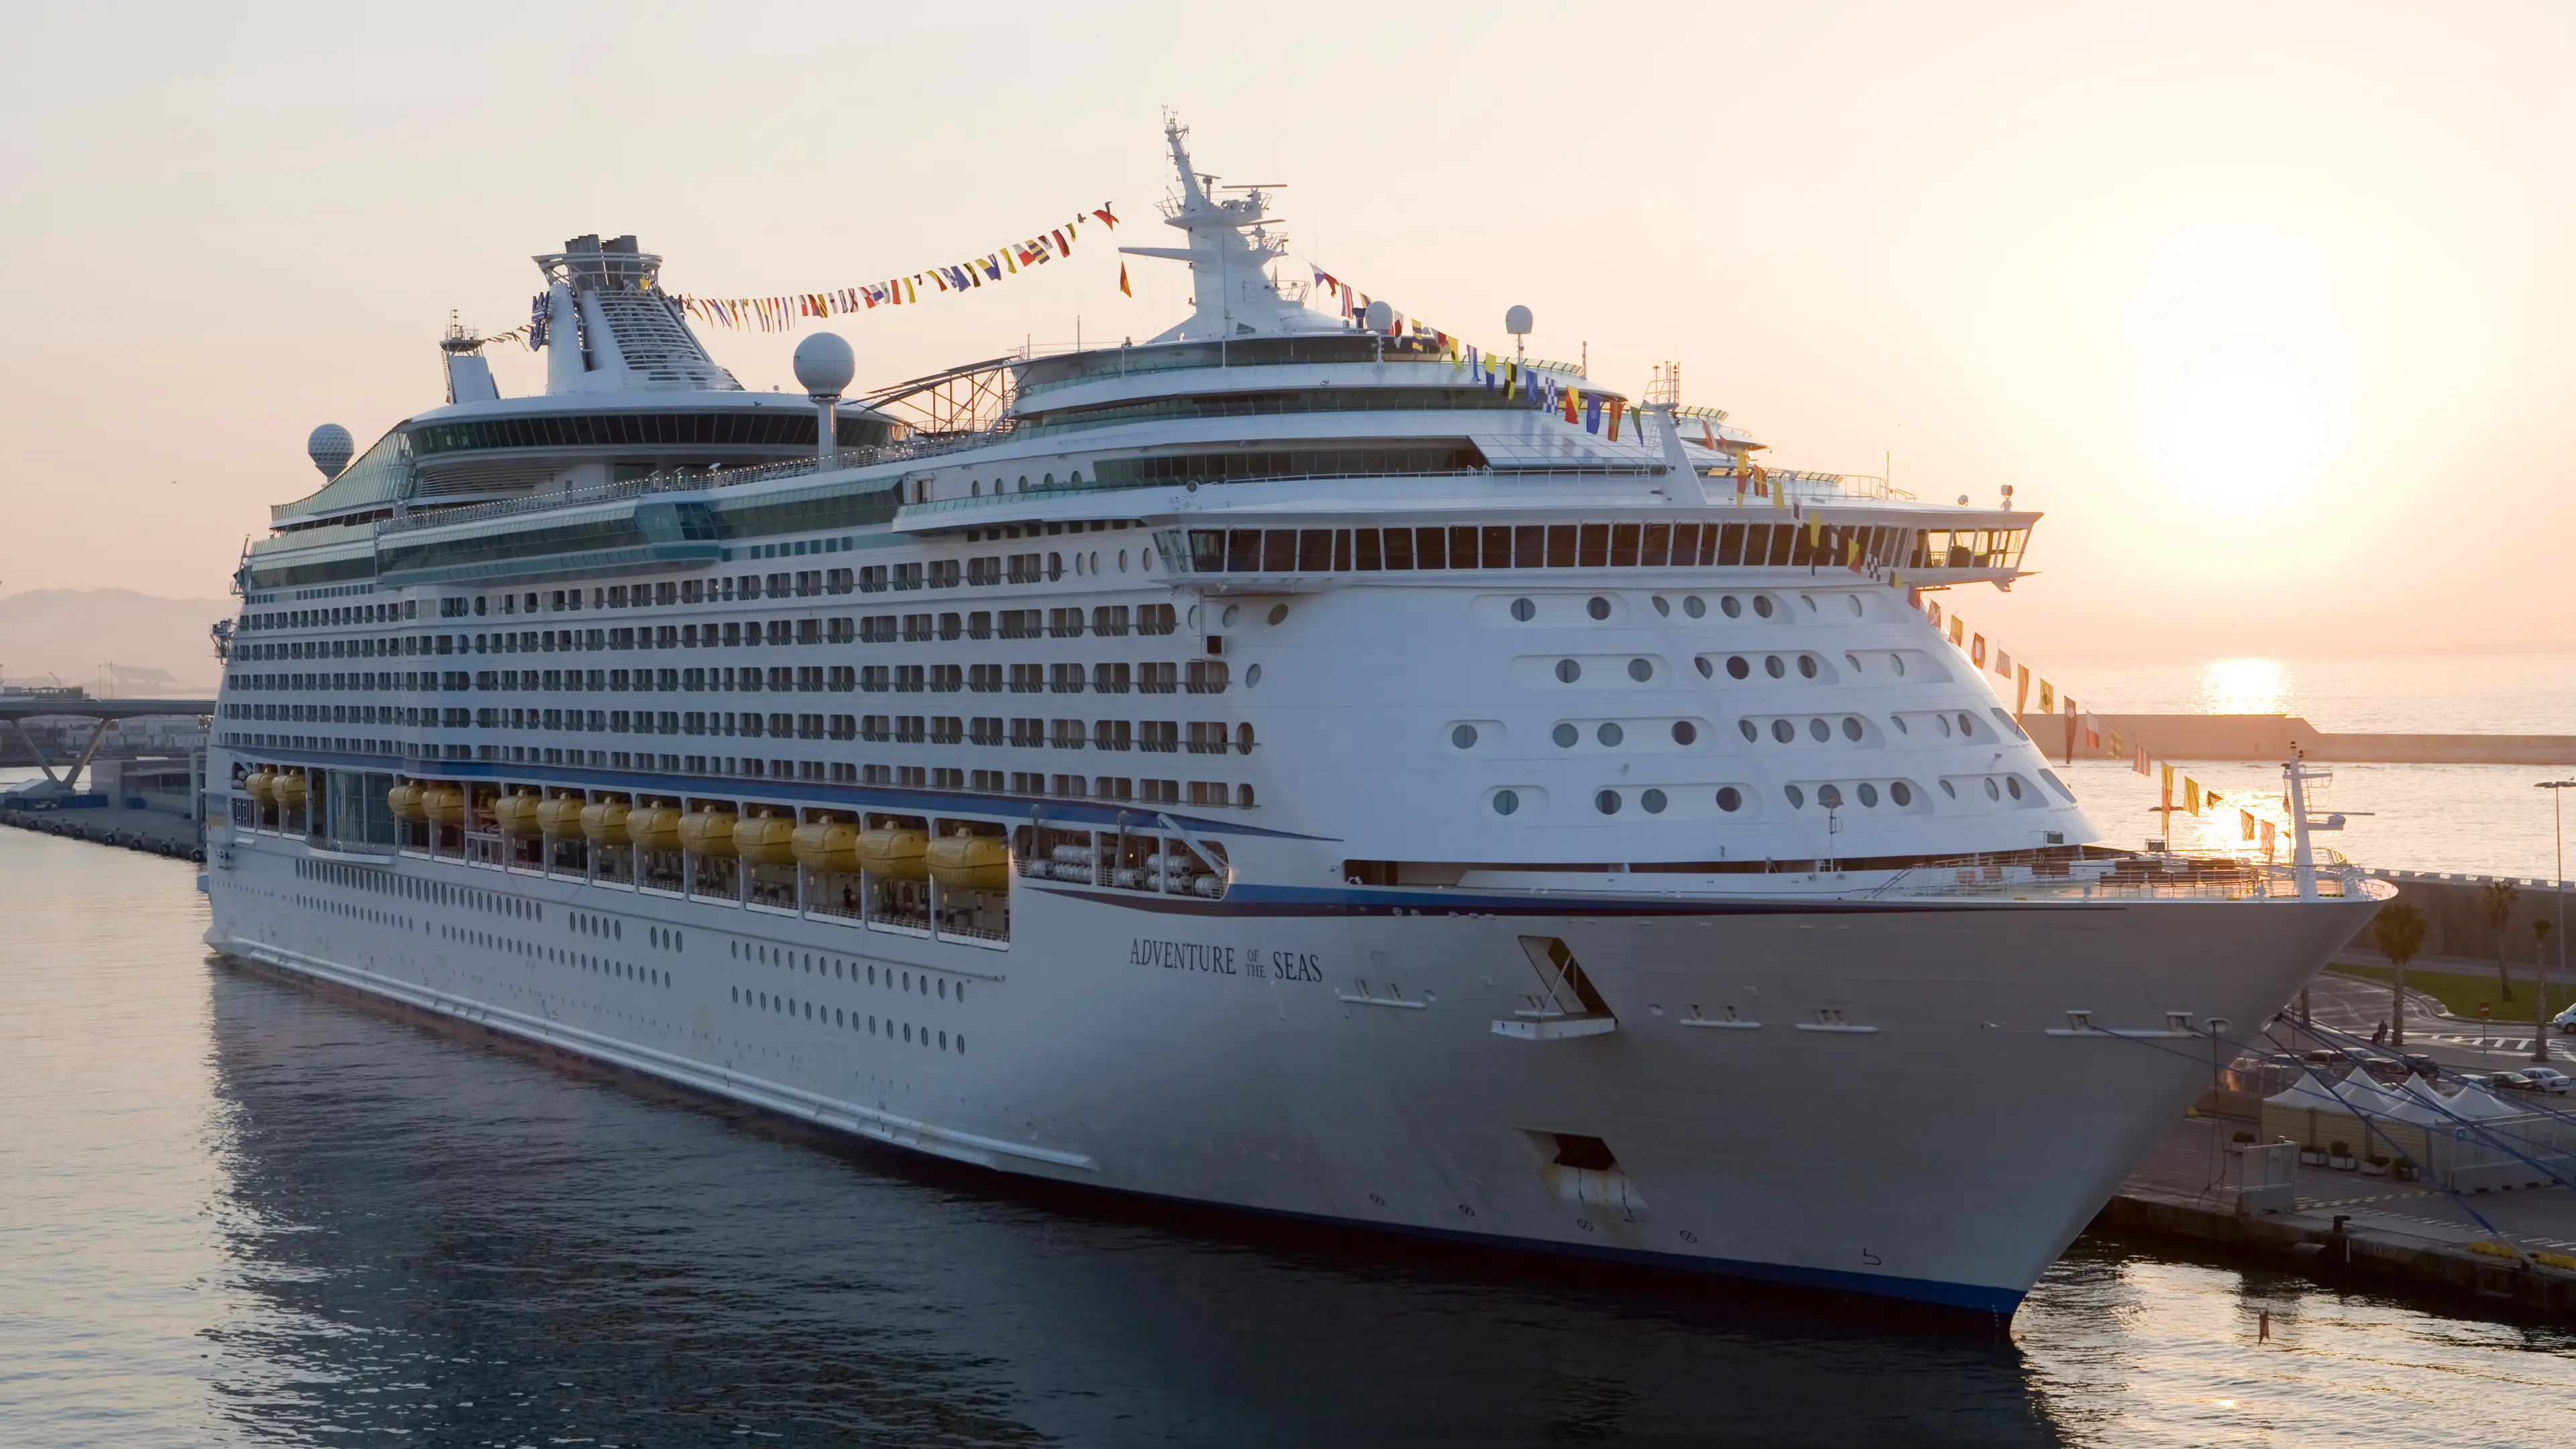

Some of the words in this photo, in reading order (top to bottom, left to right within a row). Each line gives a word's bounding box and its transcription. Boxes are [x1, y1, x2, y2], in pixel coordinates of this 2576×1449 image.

[1130, 938, 1236, 975] ADVENTURE
[1247, 949, 1260, 963] OF
[1273, 951, 1322, 983] SEAS
[1244, 963, 1267, 979] THE
